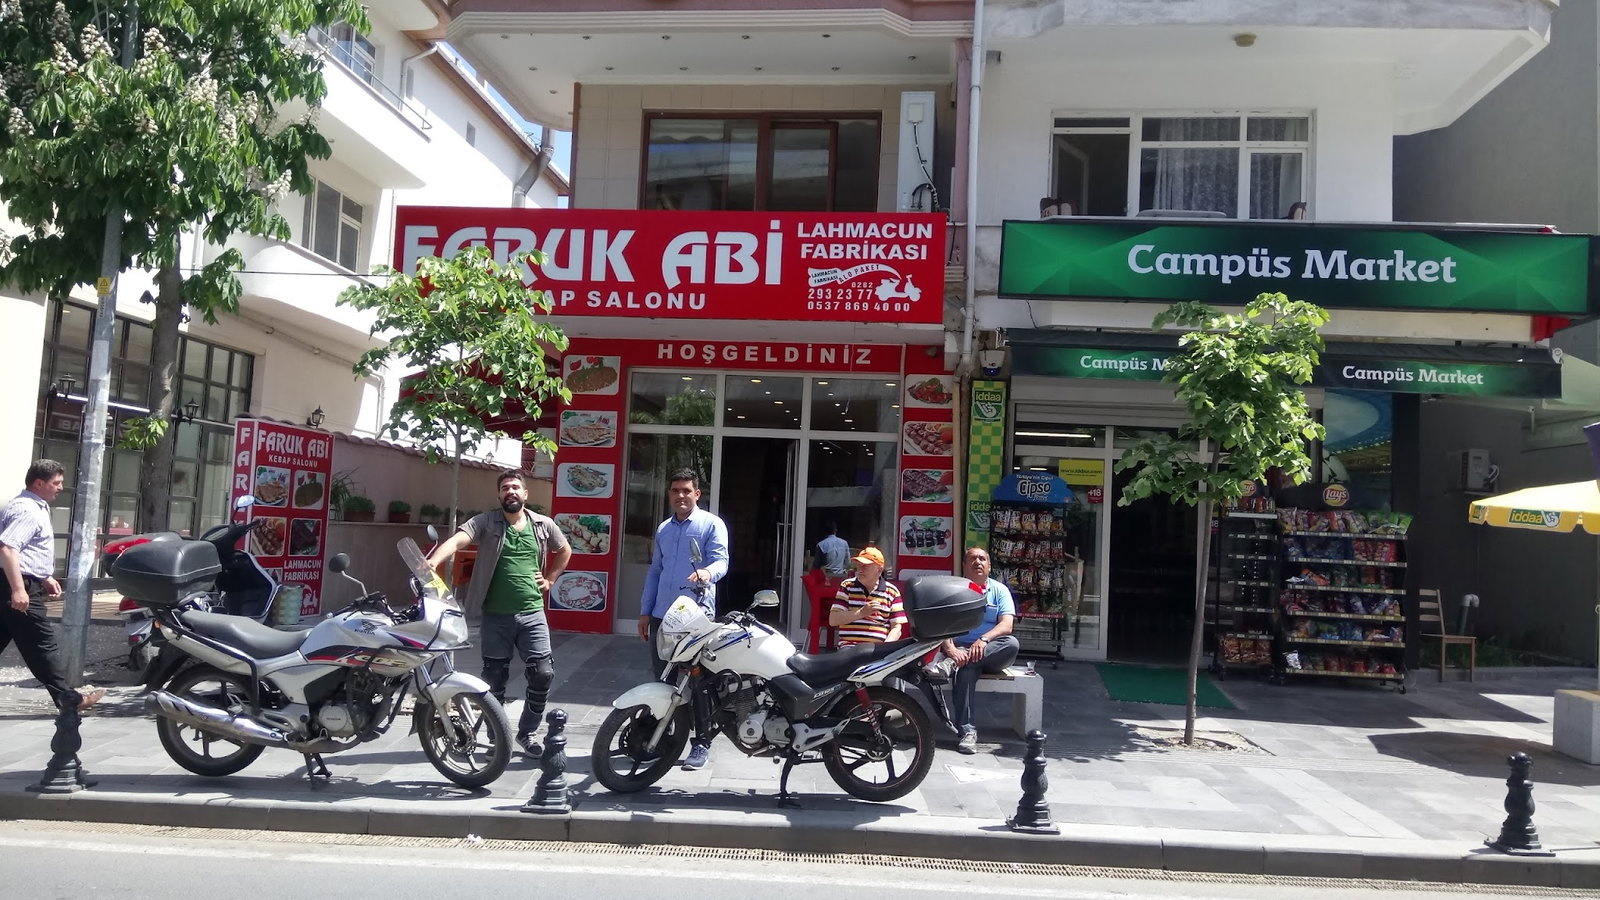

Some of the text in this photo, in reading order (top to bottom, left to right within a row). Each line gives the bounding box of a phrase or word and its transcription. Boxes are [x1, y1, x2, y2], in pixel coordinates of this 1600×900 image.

[797, 222, 933, 239] LAHMACUN
[661, 219, 784, 290] ABİ
[800, 240, 928, 260] FABRİKASI
[854, 264, 880, 275] PAKET
[1127, 244, 1457, 284] Campüs Market
[851, 281, 873, 289] 0282
[587, 290, 706, 310] SALONU
[808, 288, 873, 300] 293 23 77
[807, 301, 911, 312] 0537 869 40 00
[657, 343, 872, 365] HOŞGELDİNİZ
[1080, 355, 1148, 373] Campüs
[1342, 365, 1484, 385] Campüs Market
[975, 391, 1001, 402] iddaa
[257, 429, 330, 460] FARUK ABİ
[268, 454, 318, 468] KEBAP SALONU
[1018, 479, 1051, 497] Cipso
[1087, 488, 1102, 497] +18
[1511, 510, 1543, 524] iddaa
[284, 559, 322, 570] LAHMACUN
[284, 570, 320, 581] FABRİKASI
